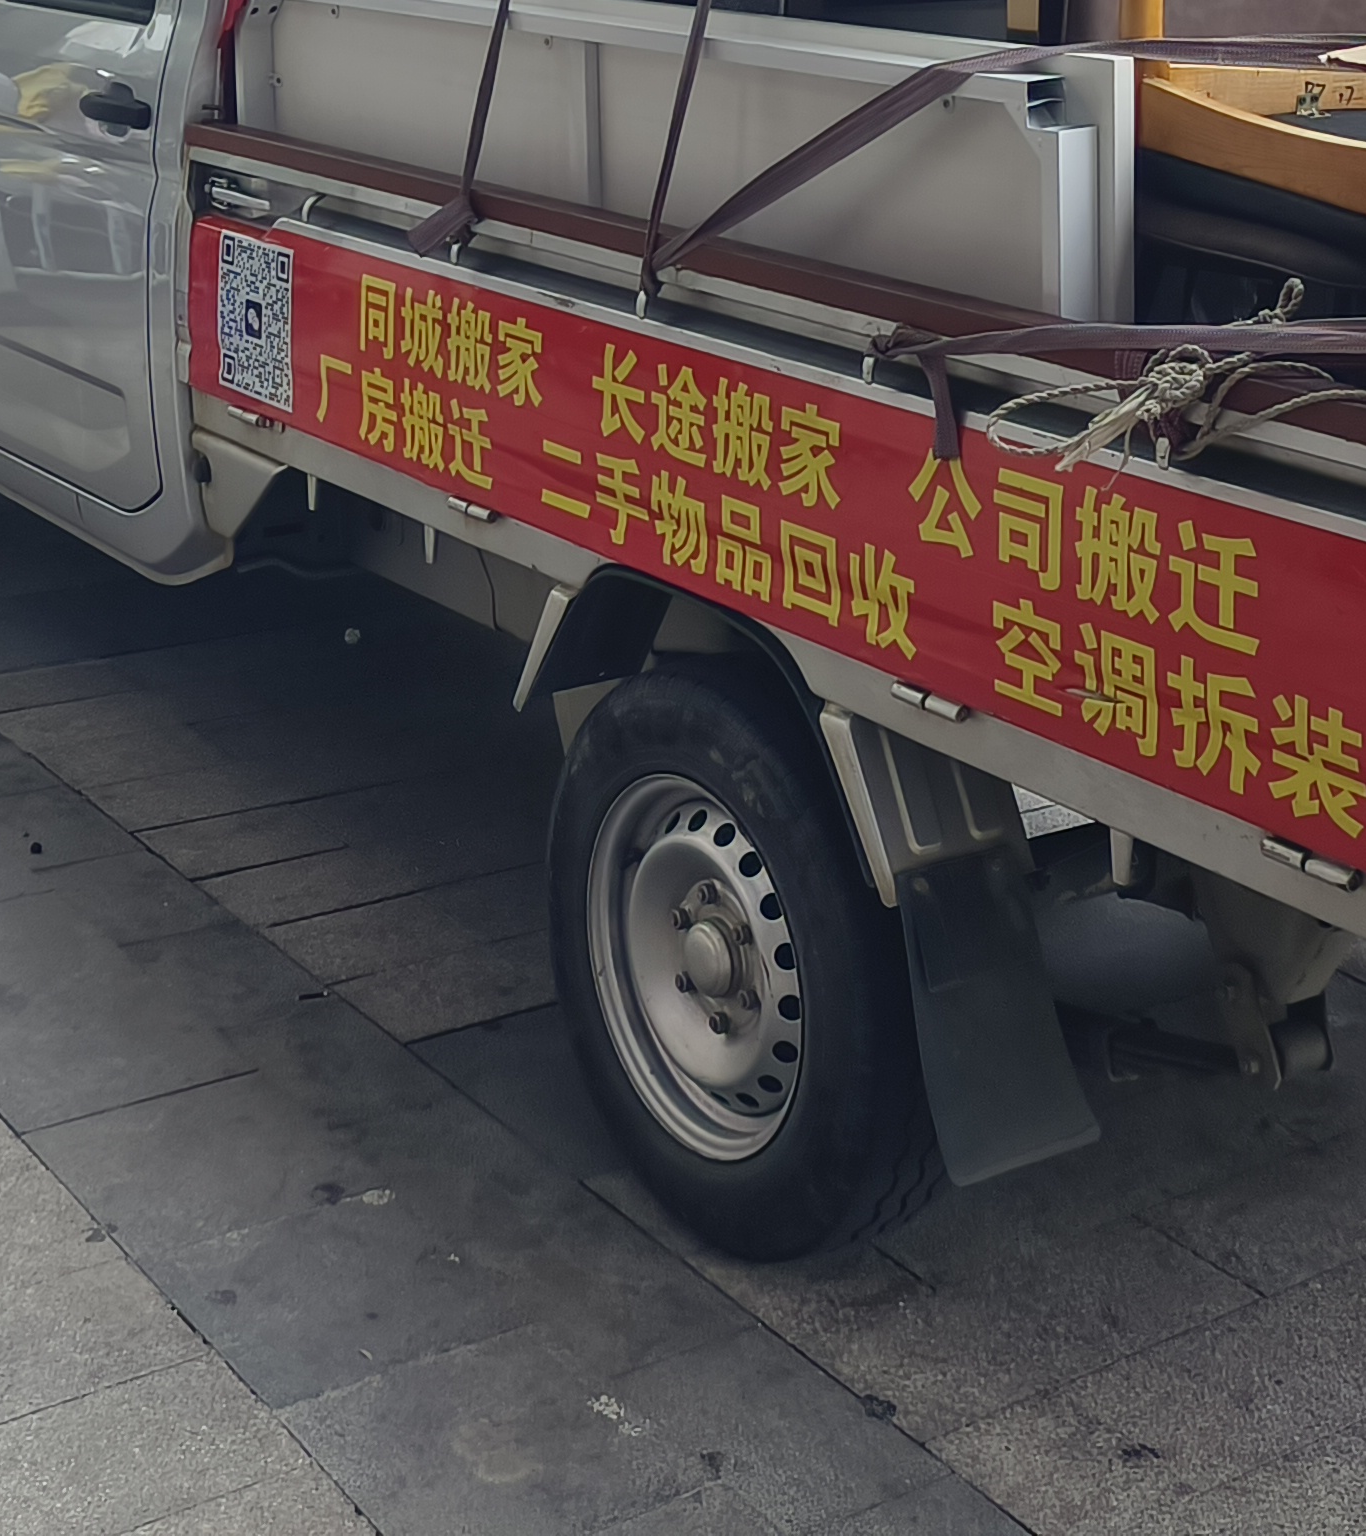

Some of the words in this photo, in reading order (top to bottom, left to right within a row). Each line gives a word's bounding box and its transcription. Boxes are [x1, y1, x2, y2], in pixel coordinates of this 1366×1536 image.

[316, 353, 493, 490] 厂房搬迁
[541, 439, 917, 661] 二手物品回收
[360, 273, 543, 408] 同城搬家
[592, 343, 841, 511] 长途搬家
[908, 448, 1260, 657] 公司搬迁
